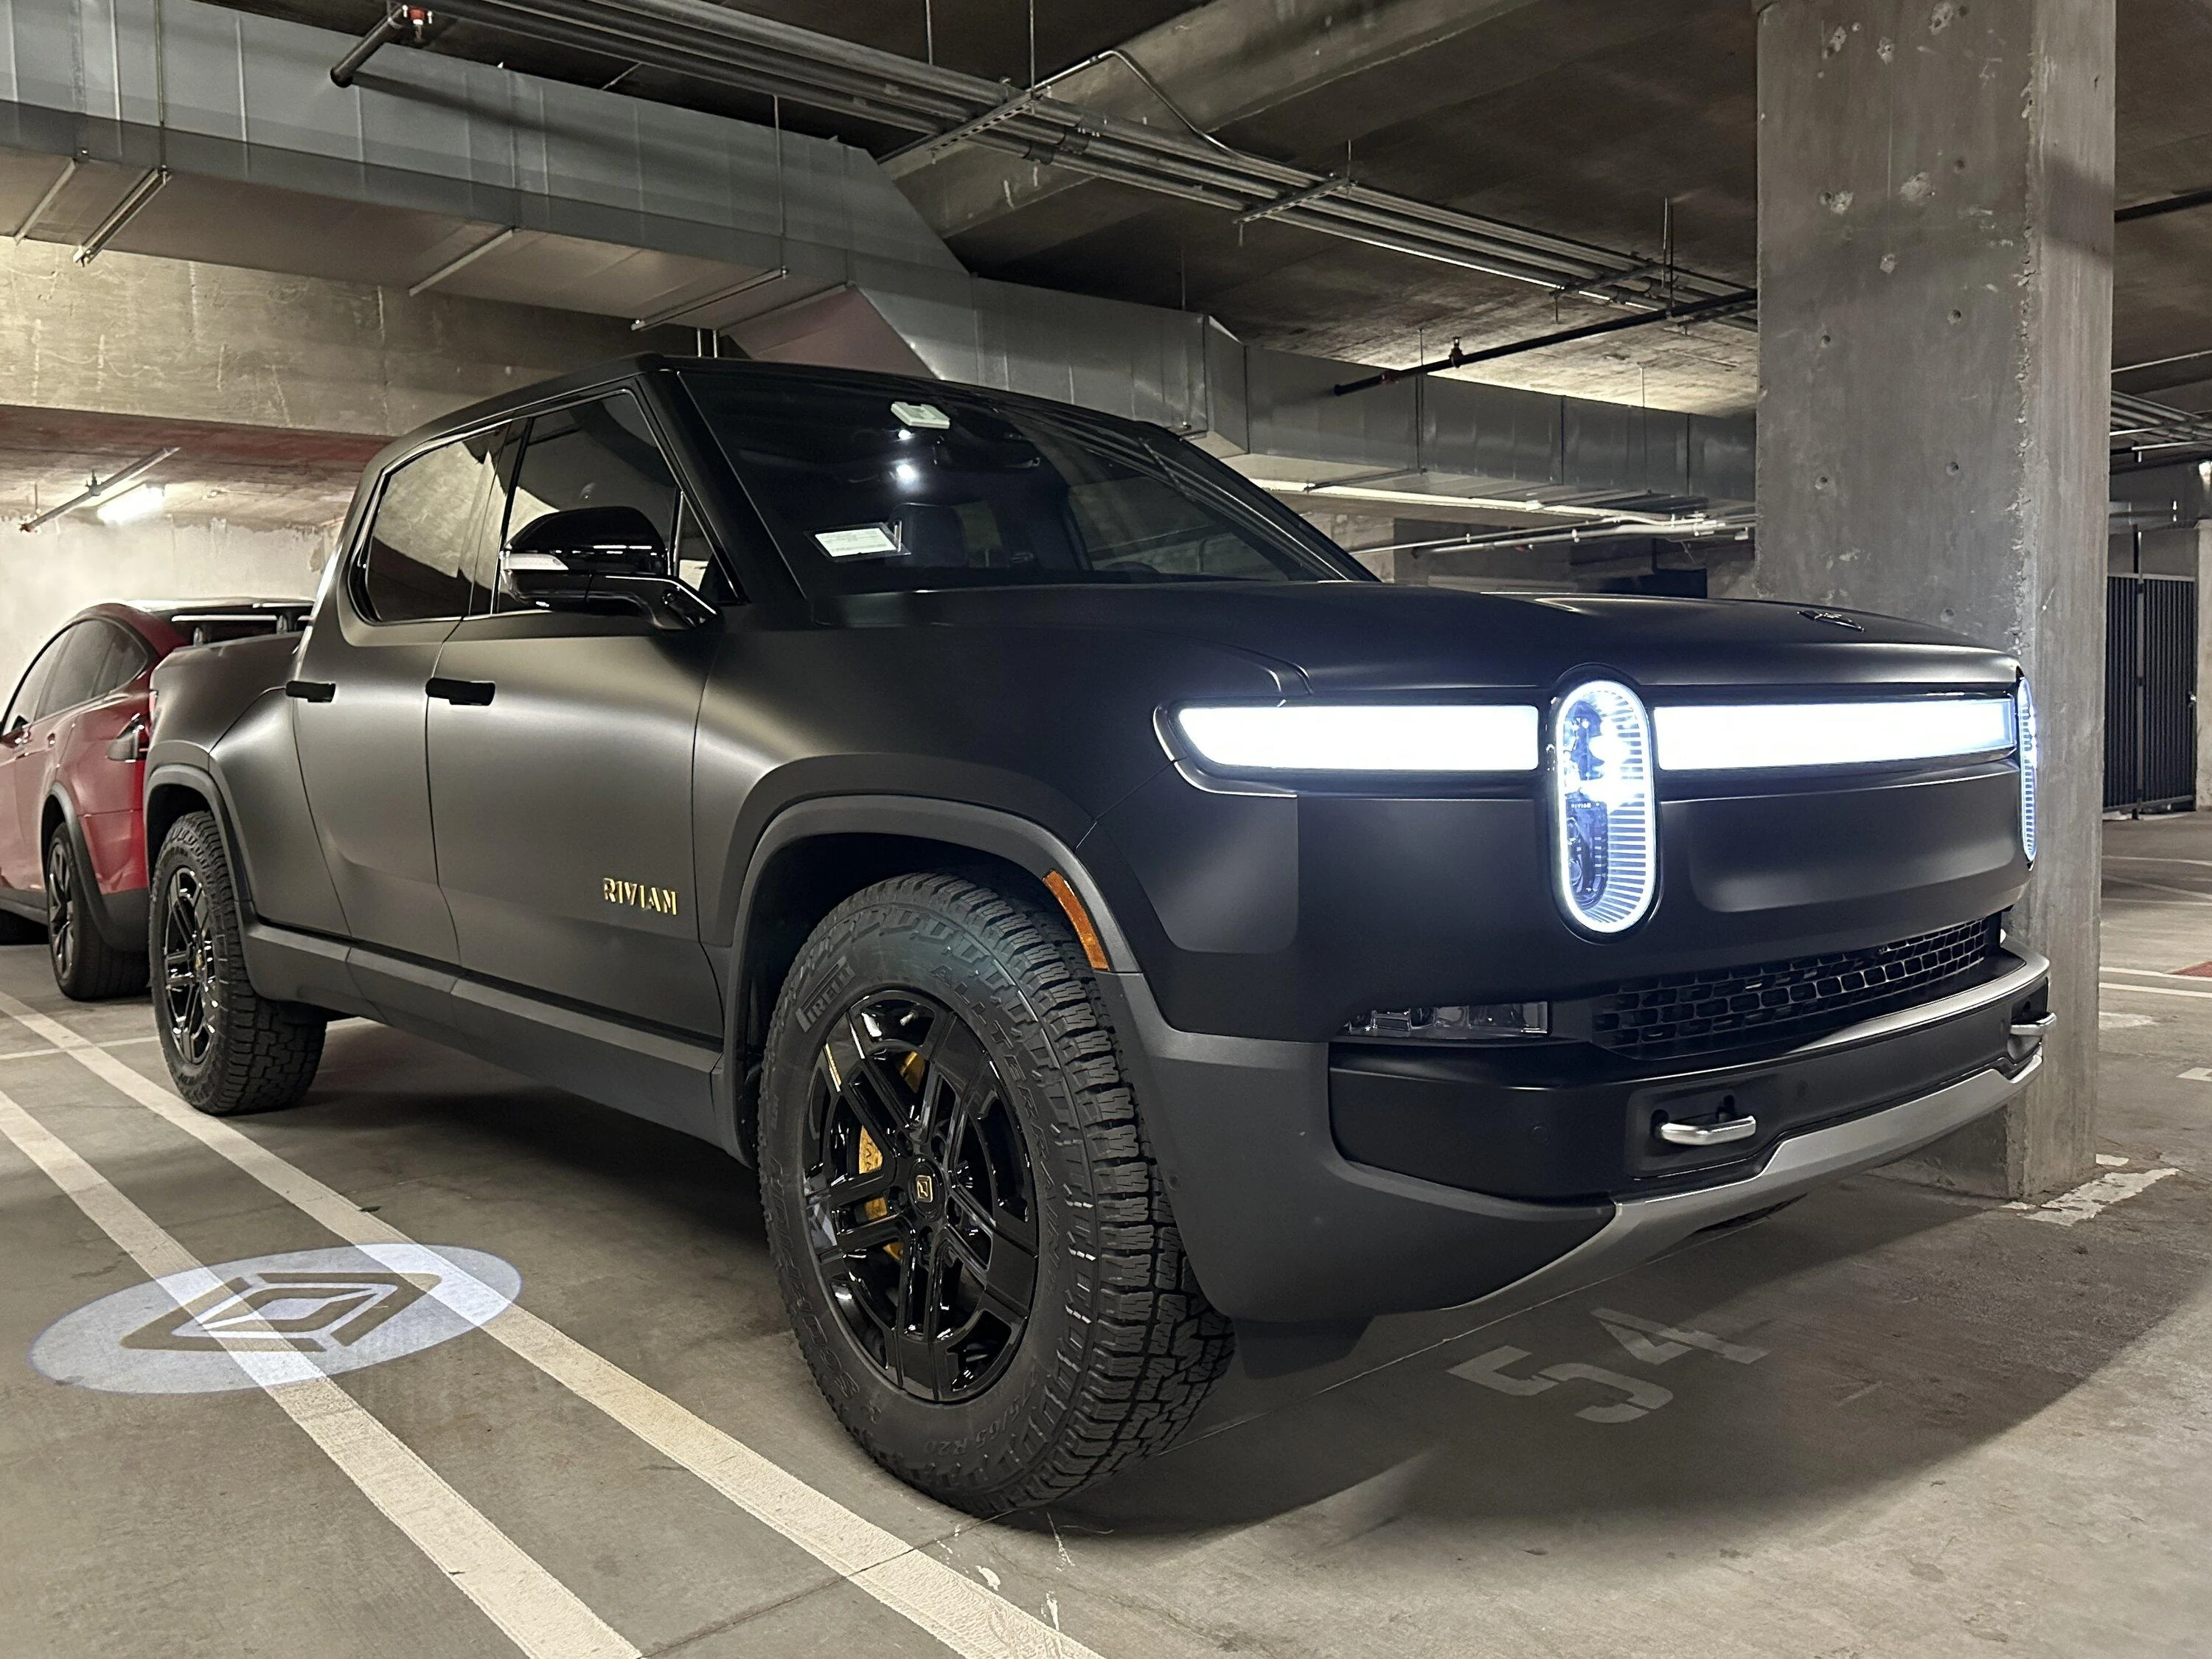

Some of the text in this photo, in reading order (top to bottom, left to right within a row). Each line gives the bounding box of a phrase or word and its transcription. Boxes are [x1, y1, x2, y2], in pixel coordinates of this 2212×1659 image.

[602, 877, 677, 915] RIVIAN
[796, 956, 856, 1032] PIRELLI
[930, 964, 987, 1025] ALL
[1447, 1307, 1770, 1423] 54
